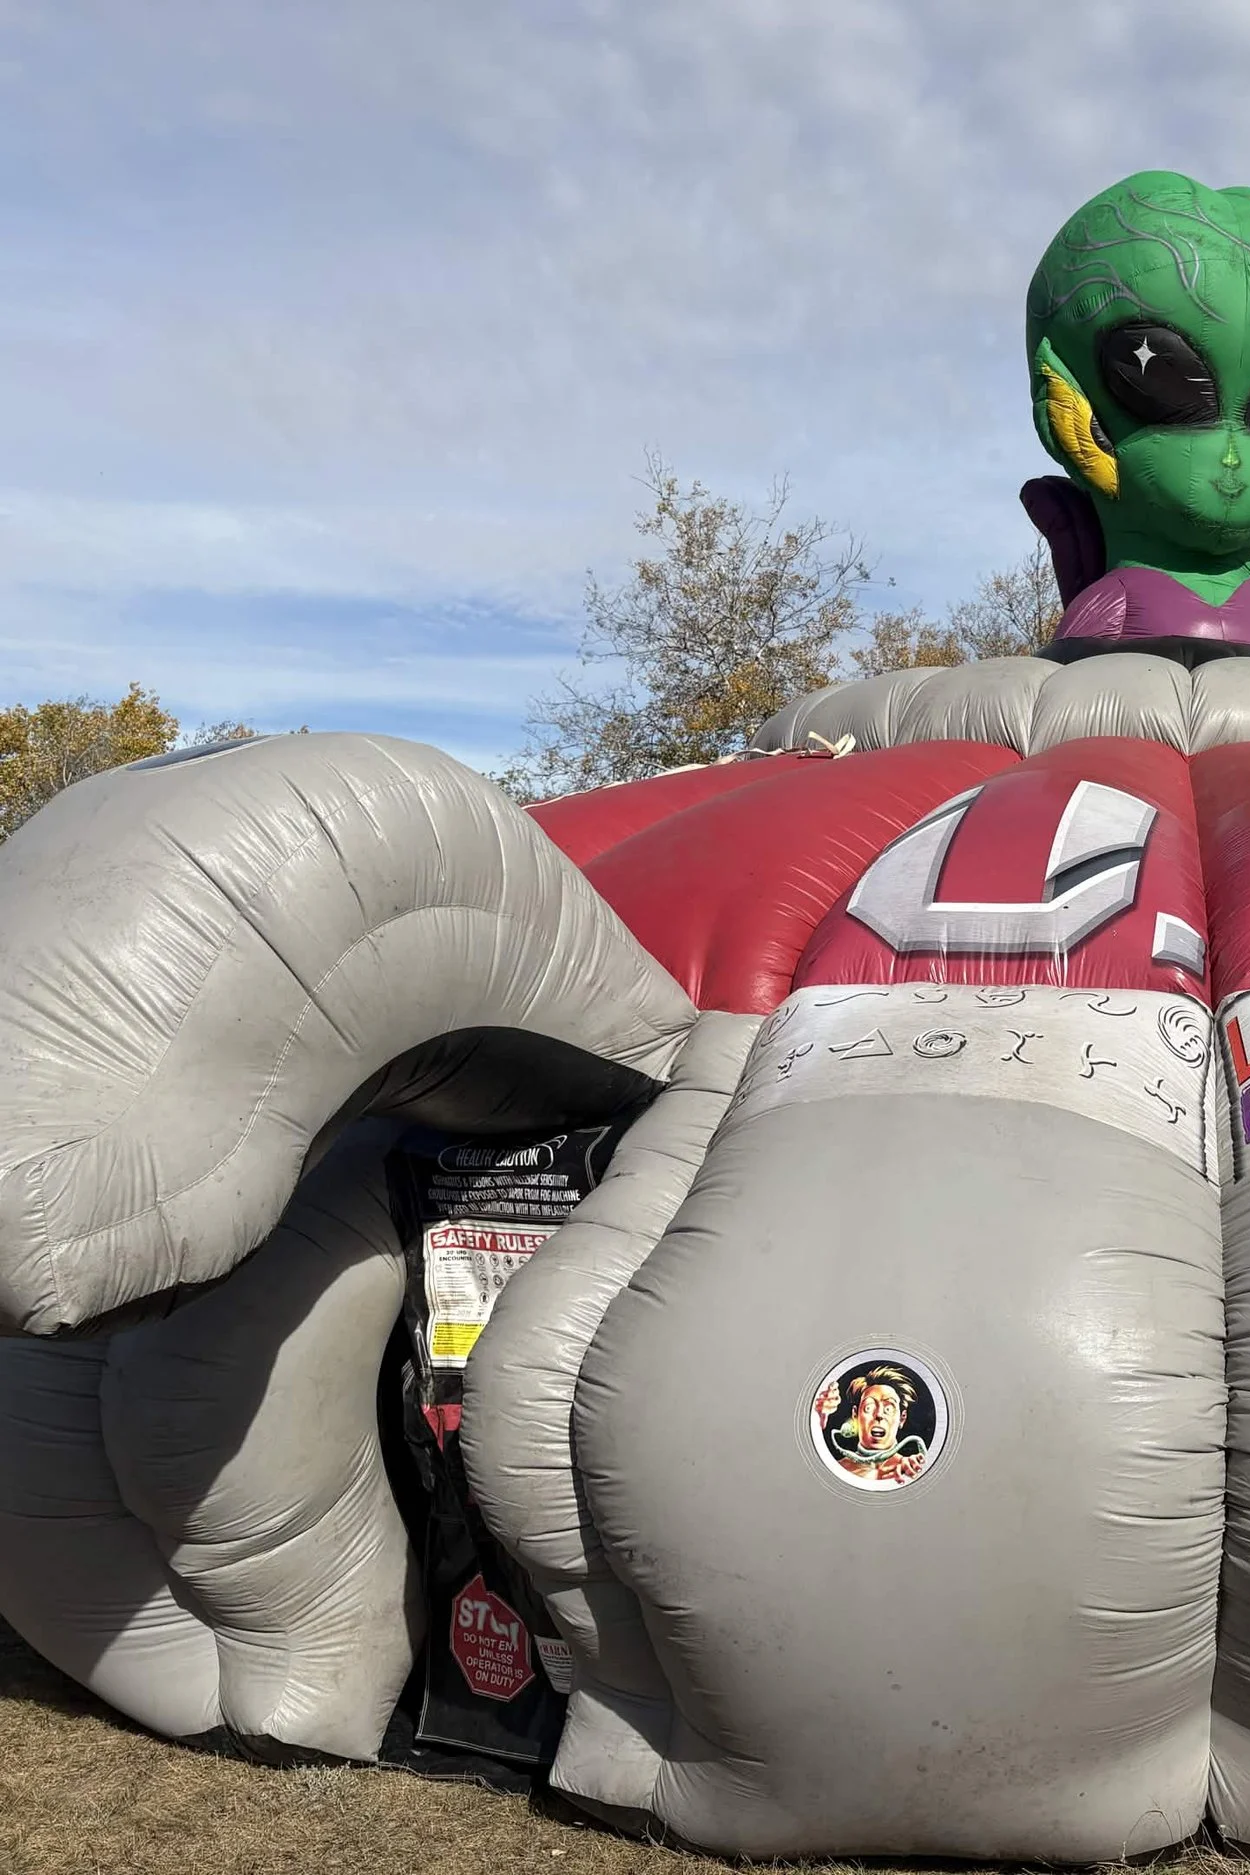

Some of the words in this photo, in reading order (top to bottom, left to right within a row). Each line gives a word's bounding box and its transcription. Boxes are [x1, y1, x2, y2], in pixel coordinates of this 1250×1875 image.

[455, 1148, 492, 1167] HEALTH
[495, 1147, 541, 1167] CAUTION
[494, 1175, 513, 1187] WITH
[524, 1188, 540, 1201] FROM
[540, 1188, 551, 1202] FOG
[551, 1189, 581, 1202] MACHINE
[514, 1202, 529, 1215] WITH
[529, 1203, 541, 1216] THIS
[432, 1229, 496, 1250] SAFETY
[496, 1233, 546, 1252] RULES
[463, 1632, 477, 1645] DO
[478, 1635, 496, 1649] NOT
[479, 1648, 514, 1666] UNLESS
[466, 1656, 513, 1677] OPERATOR
[514, 1669, 524, 1680] IS
[475, 1670, 489, 1683] ON
[490, 1675, 515, 1689] DUTY
